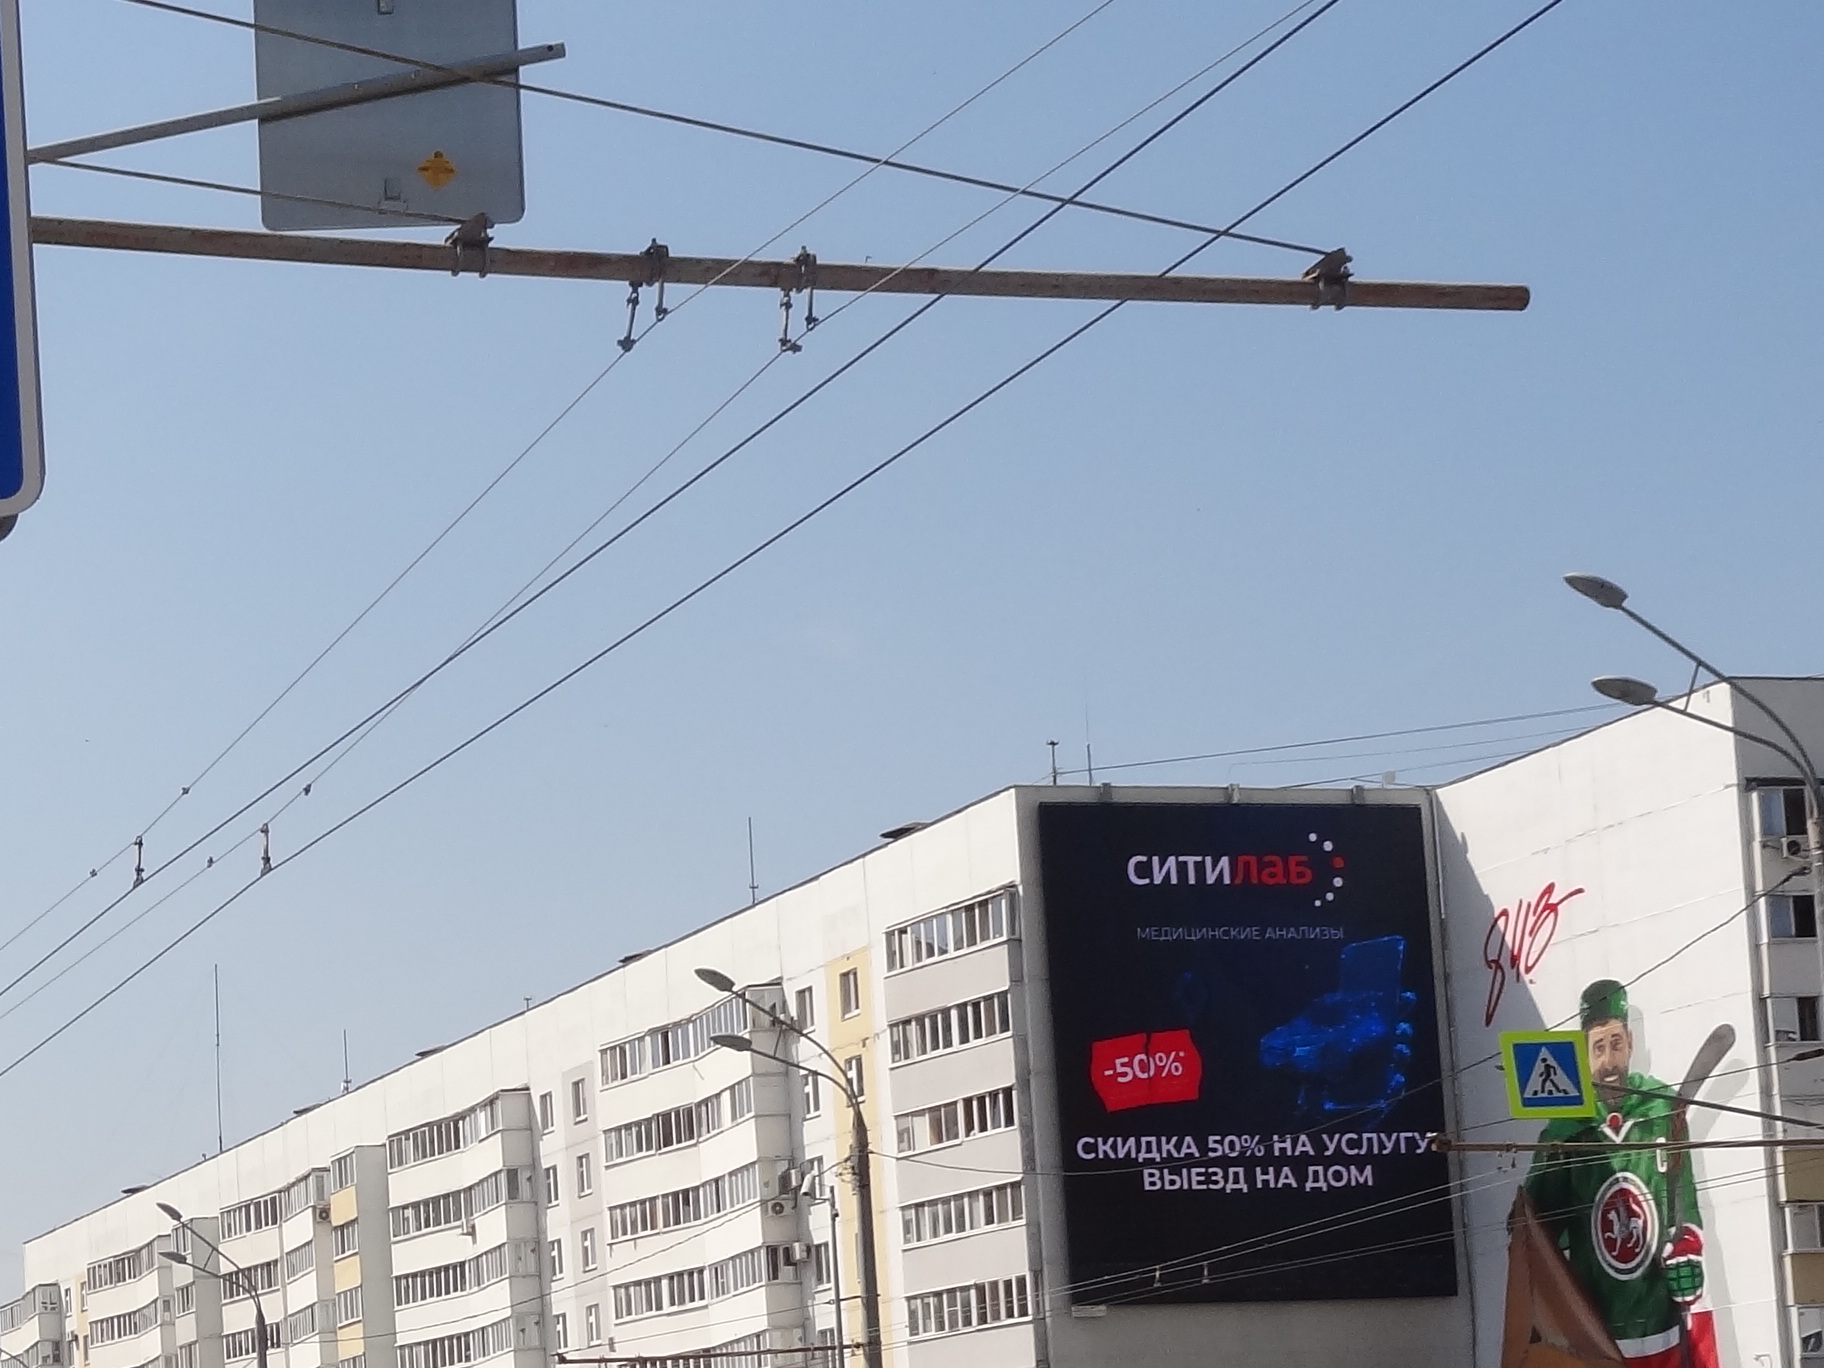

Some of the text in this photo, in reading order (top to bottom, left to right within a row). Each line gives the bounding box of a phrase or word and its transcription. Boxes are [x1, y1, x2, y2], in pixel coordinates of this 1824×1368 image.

[1137, 925, 1344, 942] МЕДИЦИНСКИЕ АНАЛИЗЫ
[1076, 1136, 1201, 1162] СКИДКА
[1207, 1134, 1265, 1158] 50%
[1272, 1134, 1319, 1157] НА
[1142, 1164, 1374, 1192] ВЫЕЗД НА ДОМ
